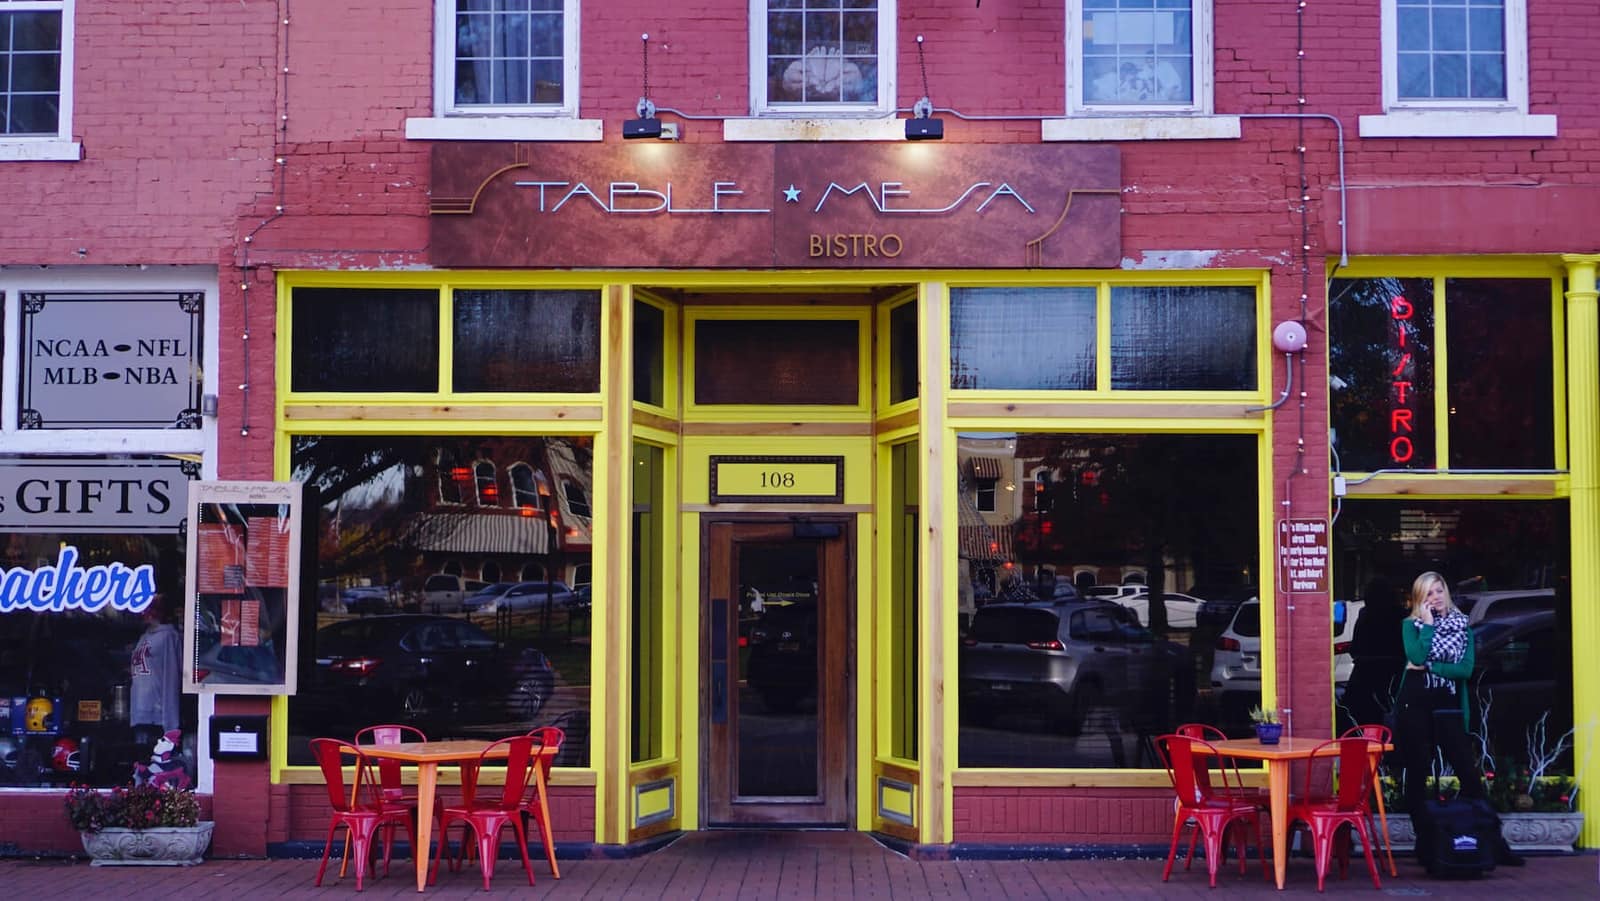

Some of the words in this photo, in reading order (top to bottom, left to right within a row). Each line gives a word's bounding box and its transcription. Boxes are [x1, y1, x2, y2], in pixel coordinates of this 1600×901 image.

[514, 181, 771, 213] TABLE
[814, 181, 1035, 213] MESA
[809, 233, 904, 258] BISTRO
[35, 339, 110, 357] NCAA
[137, 339, 187, 357] NFL
[44, 367, 98, 385] MLB
[125, 367, 179, 385] NBA
[1390, 296, 1415, 462] BISTRO
[760, 472, 795, 488] 108
[16, 479, 171, 514] GIFTS
[0, 546, 156, 612] achers
